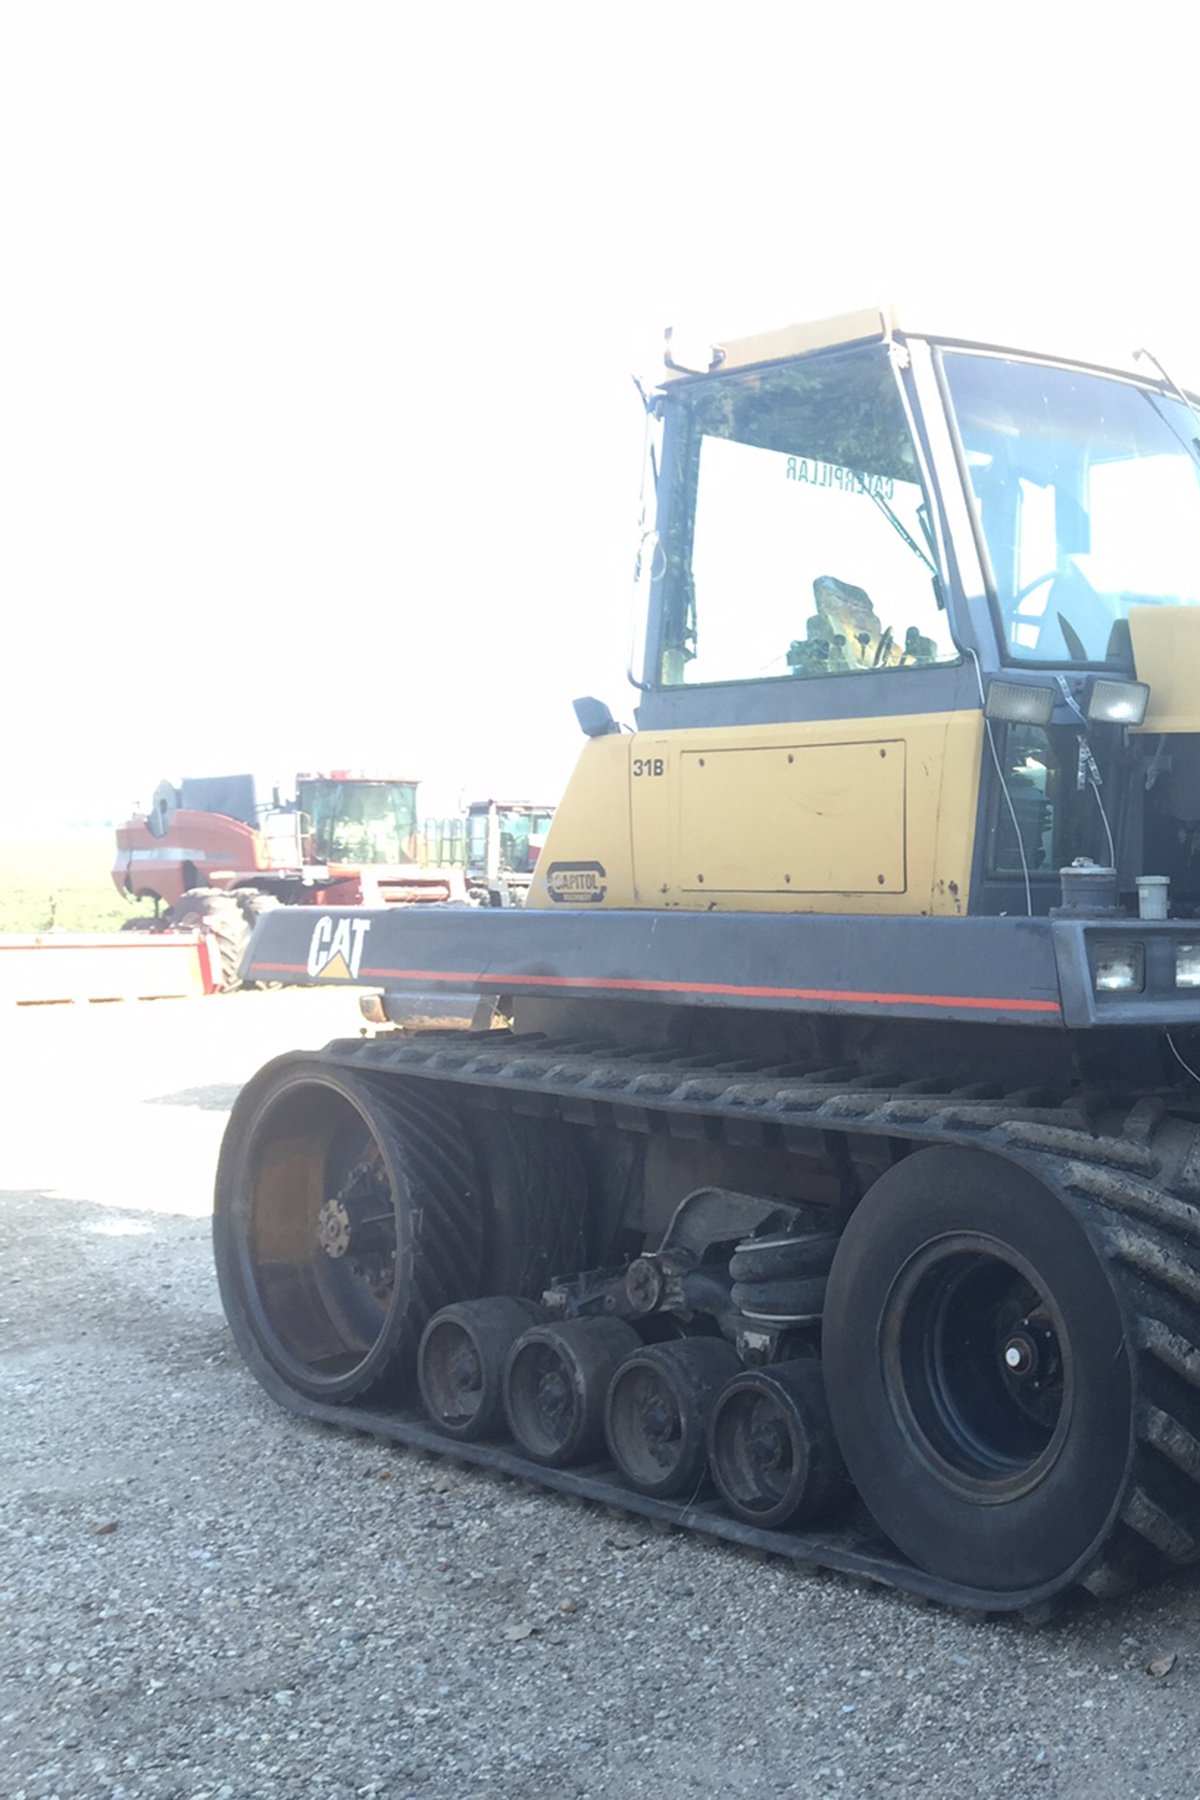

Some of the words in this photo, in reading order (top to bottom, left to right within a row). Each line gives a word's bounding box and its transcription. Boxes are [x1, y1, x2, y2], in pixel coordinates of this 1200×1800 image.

[633, 758, 664, 777] 31B
[554, 873, 599, 891] CAPITOL
[307, 915, 371, 979] CAT
